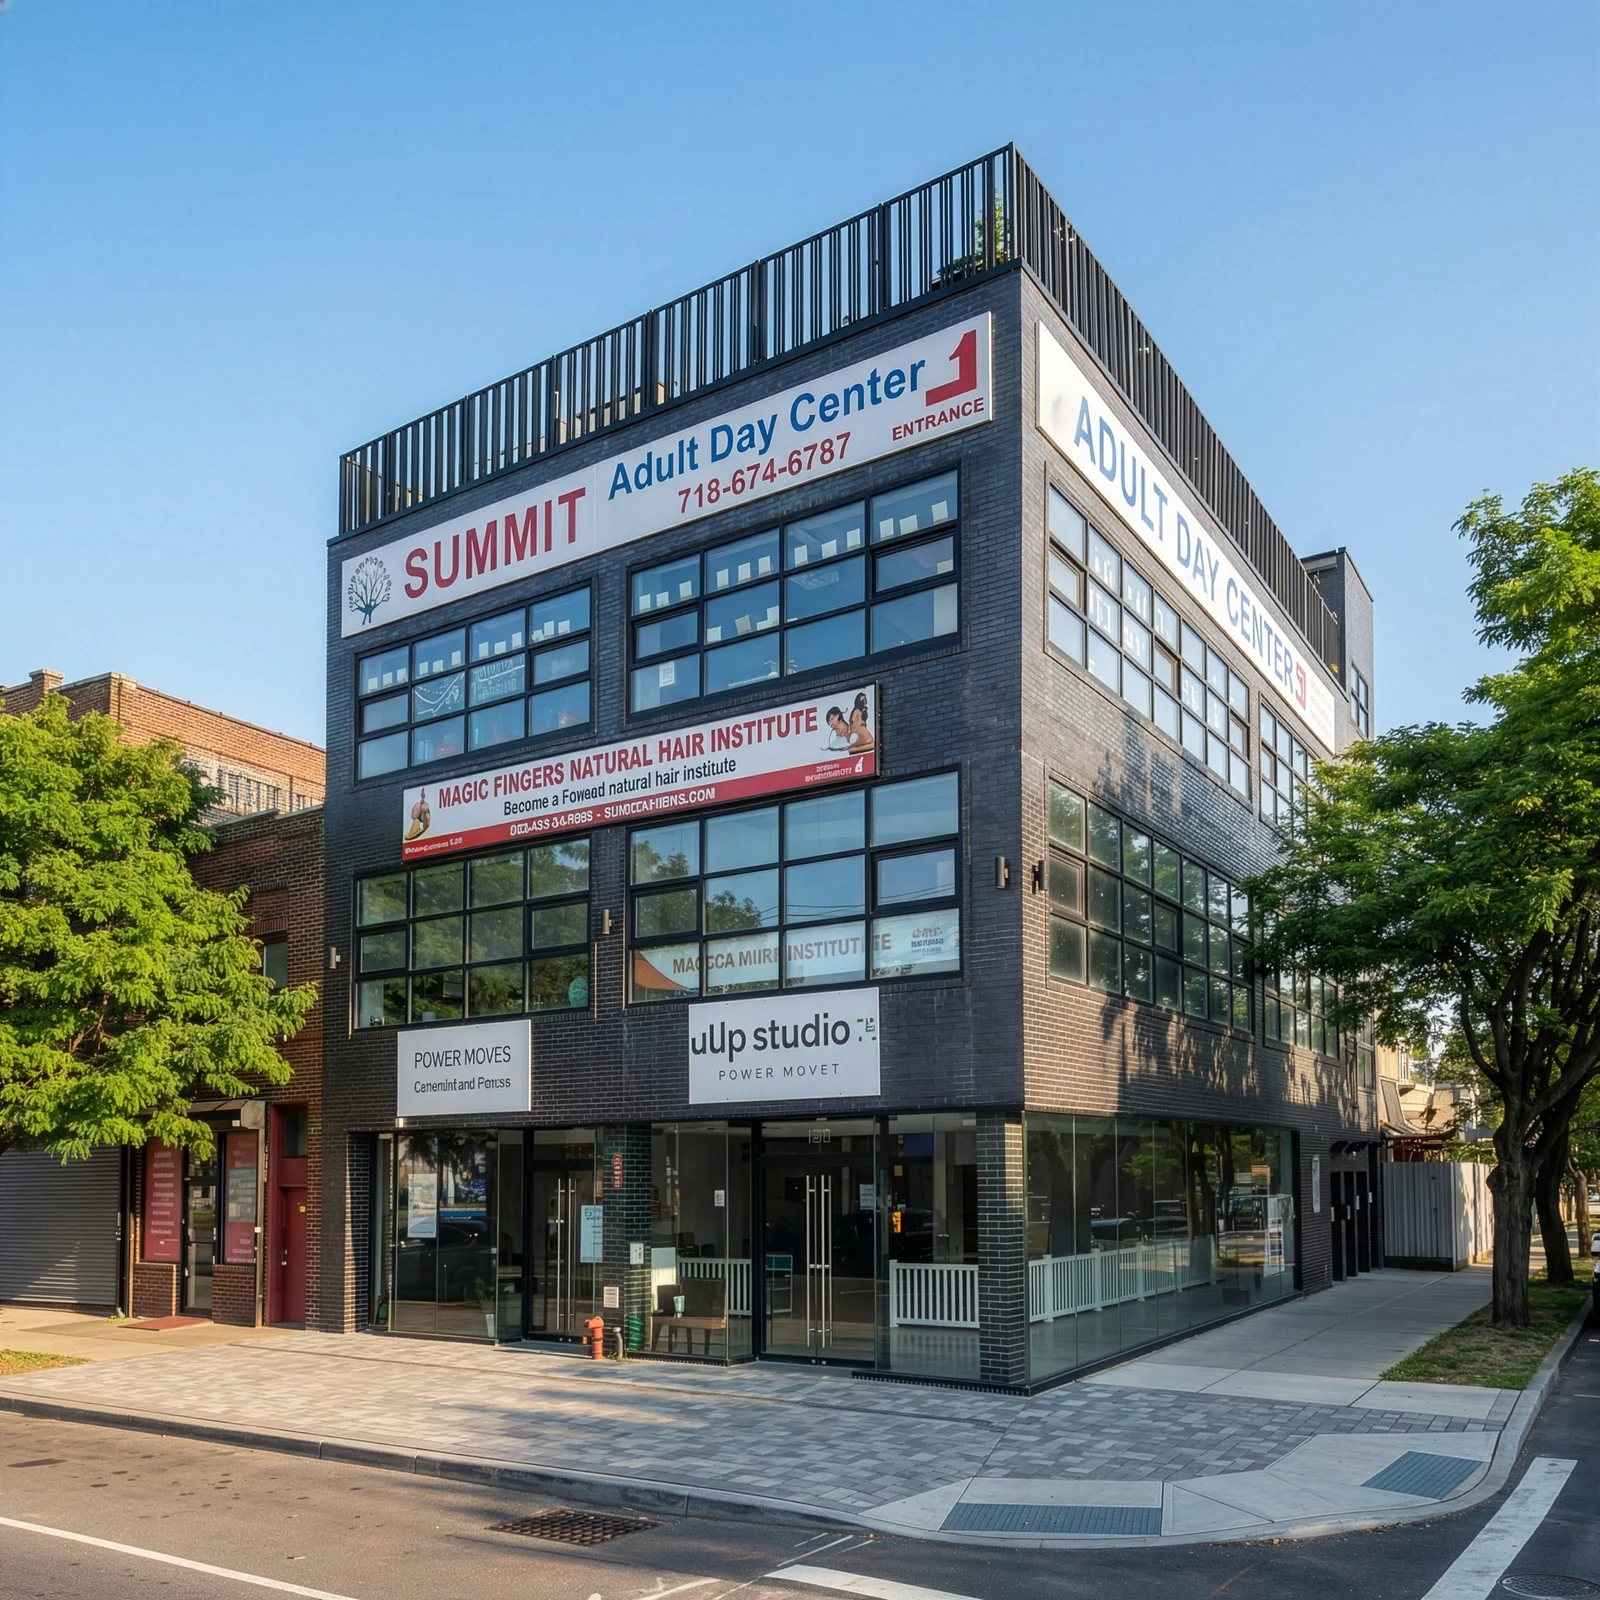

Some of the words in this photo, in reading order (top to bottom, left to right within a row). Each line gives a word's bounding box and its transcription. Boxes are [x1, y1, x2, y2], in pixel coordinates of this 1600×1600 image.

[608, 435, 699, 500] Adult
[710, 413, 777, 464] Day
[789, 358, 926, 433] Center
[891, 397, 985, 442] ENTRANCE
[677, 431, 851, 514] 718-674-6787
[404, 487, 586, 599] SUMMIT
[1074, 395, 1168, 541] ADULT
[1177, 511, 1219, 602] DAY
[1226, 577, 1293, 694] CENTER
[438, 780, 489, 810] MAGIC
[494, 763, 565, 799] FINGERS
[570, 745, 653, 782] NATURAL
[658, 732, 706, 763] HAIR
[710, 707, 819, 753] INSTITUTE
[504, 795, 549, 816] Become
[552, 794, 559, 806] a
[608, 772, 651, 796] natural
[656, 769, 680, 787] hair
[683, 757, 737, 785] institute
[414, 1049, 462, 1069] POWER
[464, 1045, 511, 1066] MOVES
[752, 1012, 851, 1051] studio
[458, 1077, 475, 1090] and
[718, 1067, 774, 1081] POWER
[783, 1063, 840, 1078] MOVET
